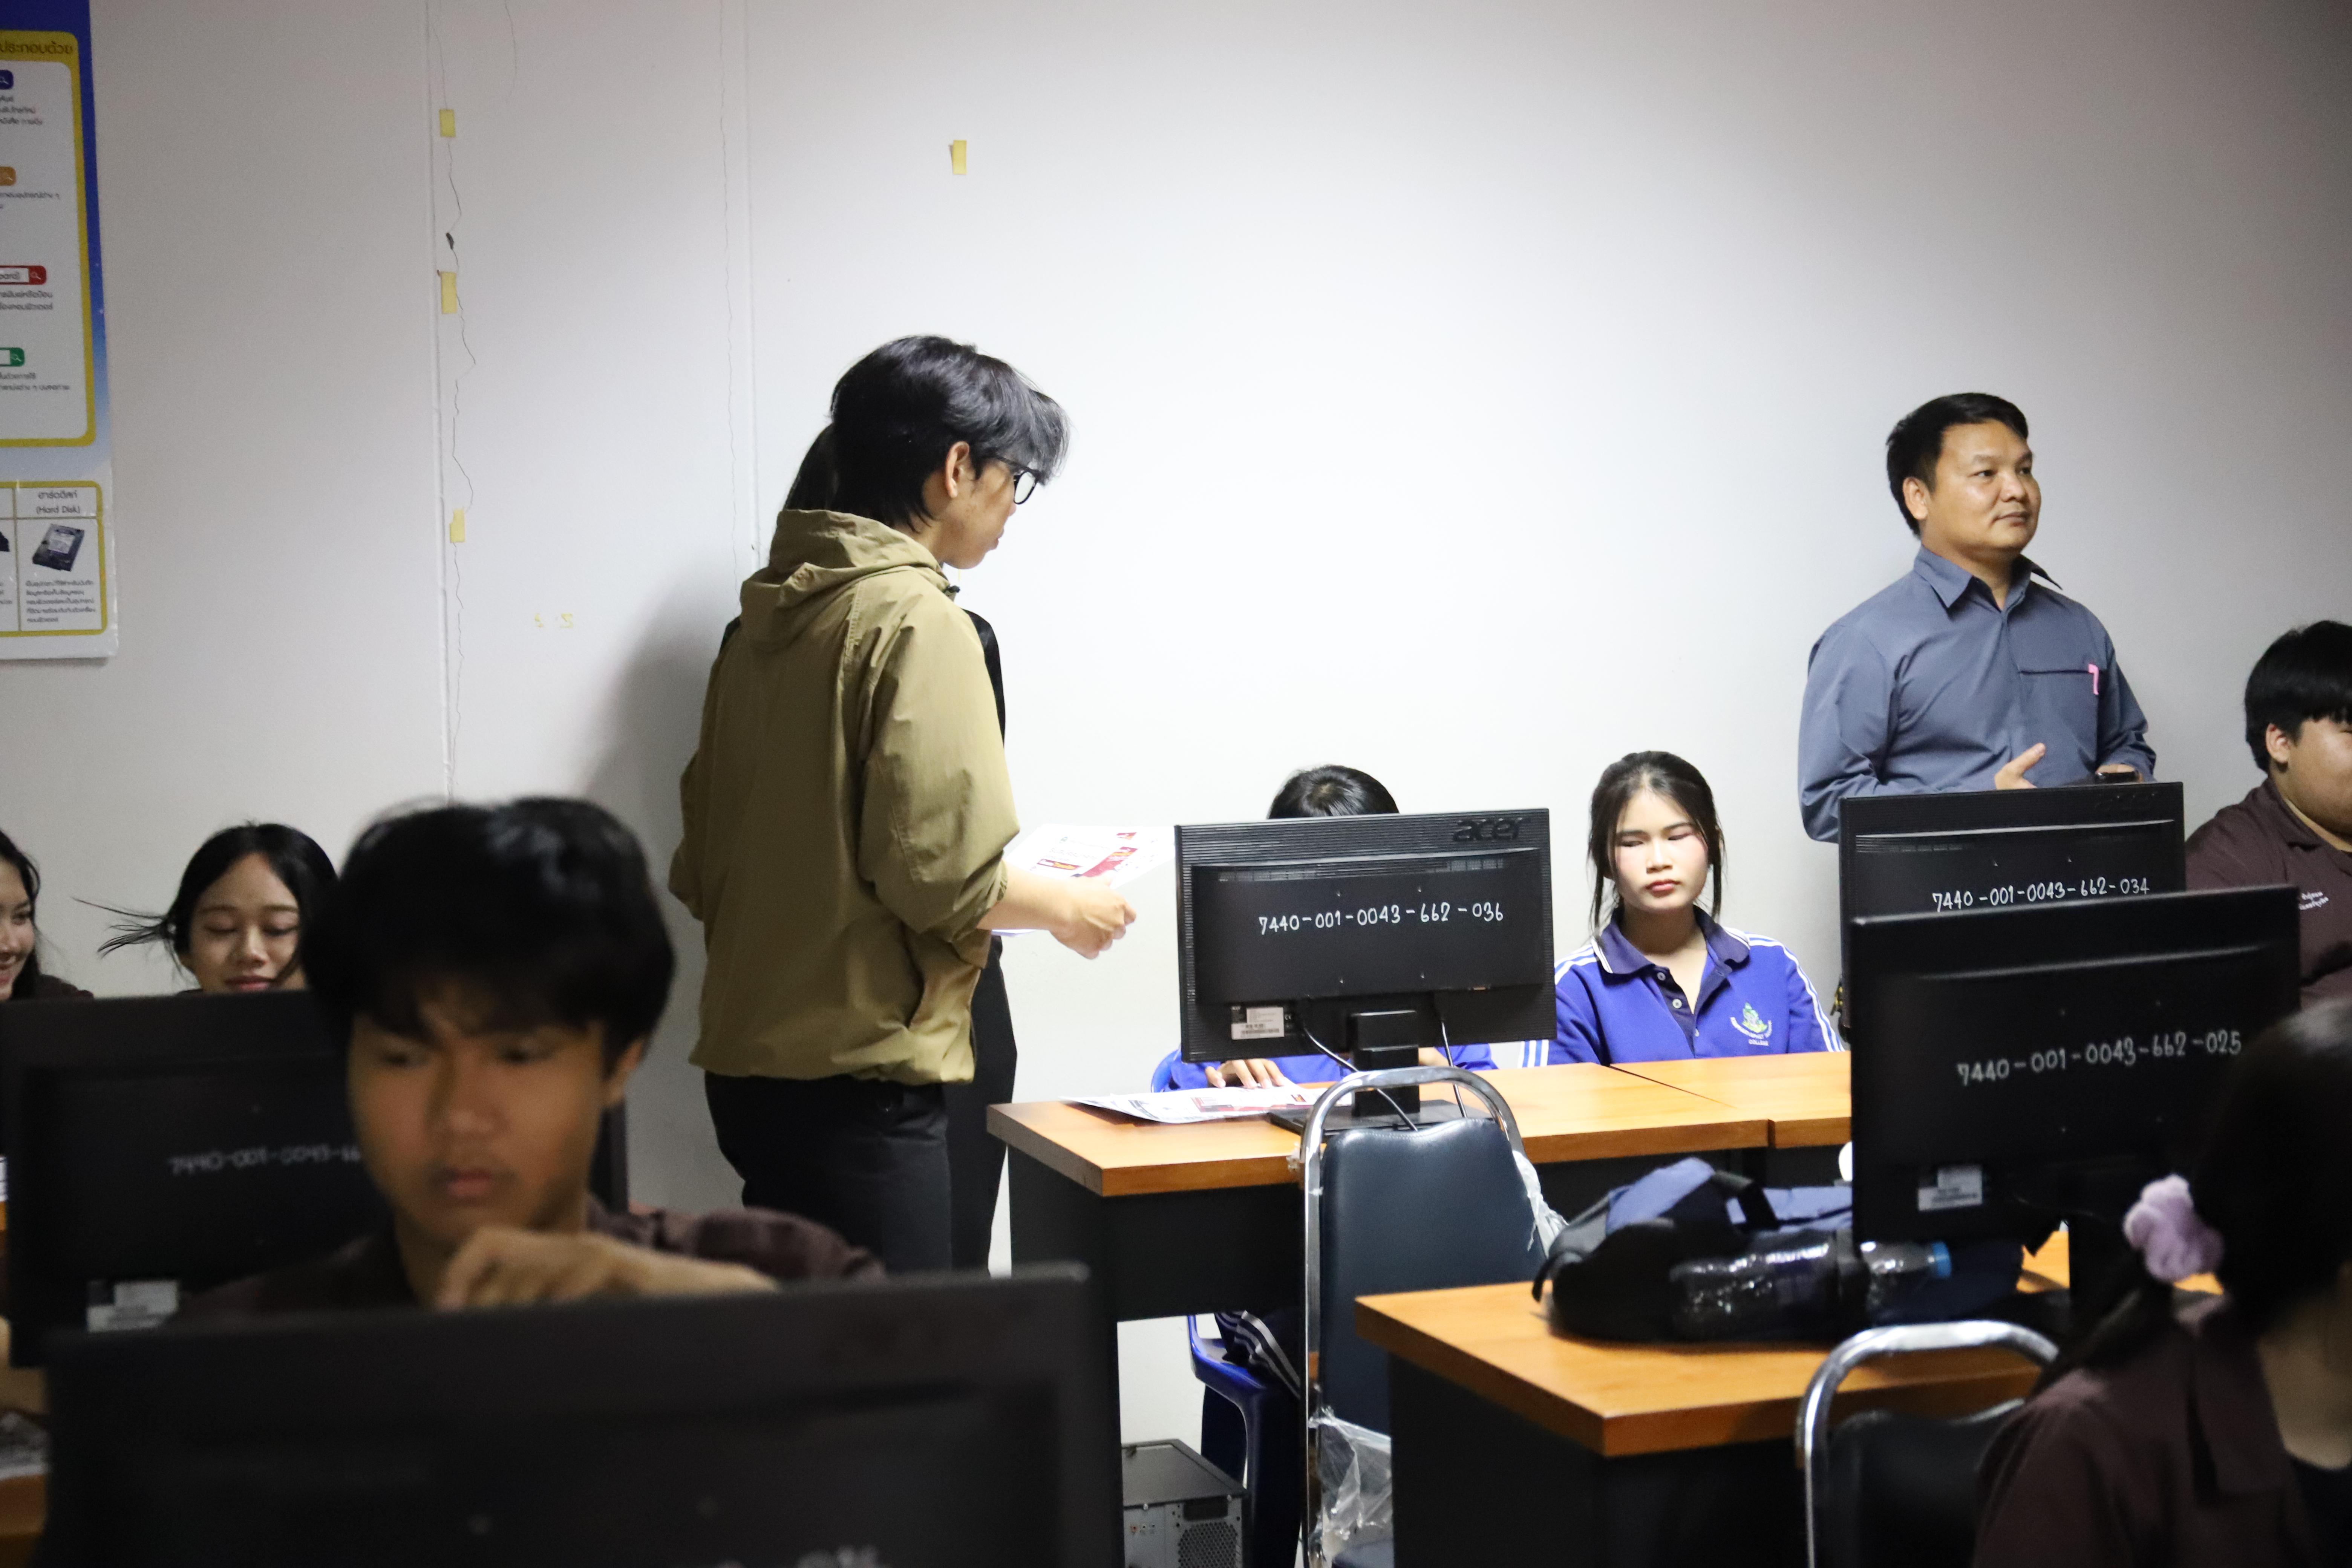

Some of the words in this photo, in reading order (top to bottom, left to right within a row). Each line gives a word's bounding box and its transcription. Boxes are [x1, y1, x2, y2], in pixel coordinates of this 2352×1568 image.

[1453, 815, 1531, 842] acer
[1931, 876, 2150, 913] 7440-001-0043-662-034
[1258, 901, 1504, 936] 7440-001-0043-662-036
[1955, 1028, 2243, 1087] 7440-001-0043-662-025
